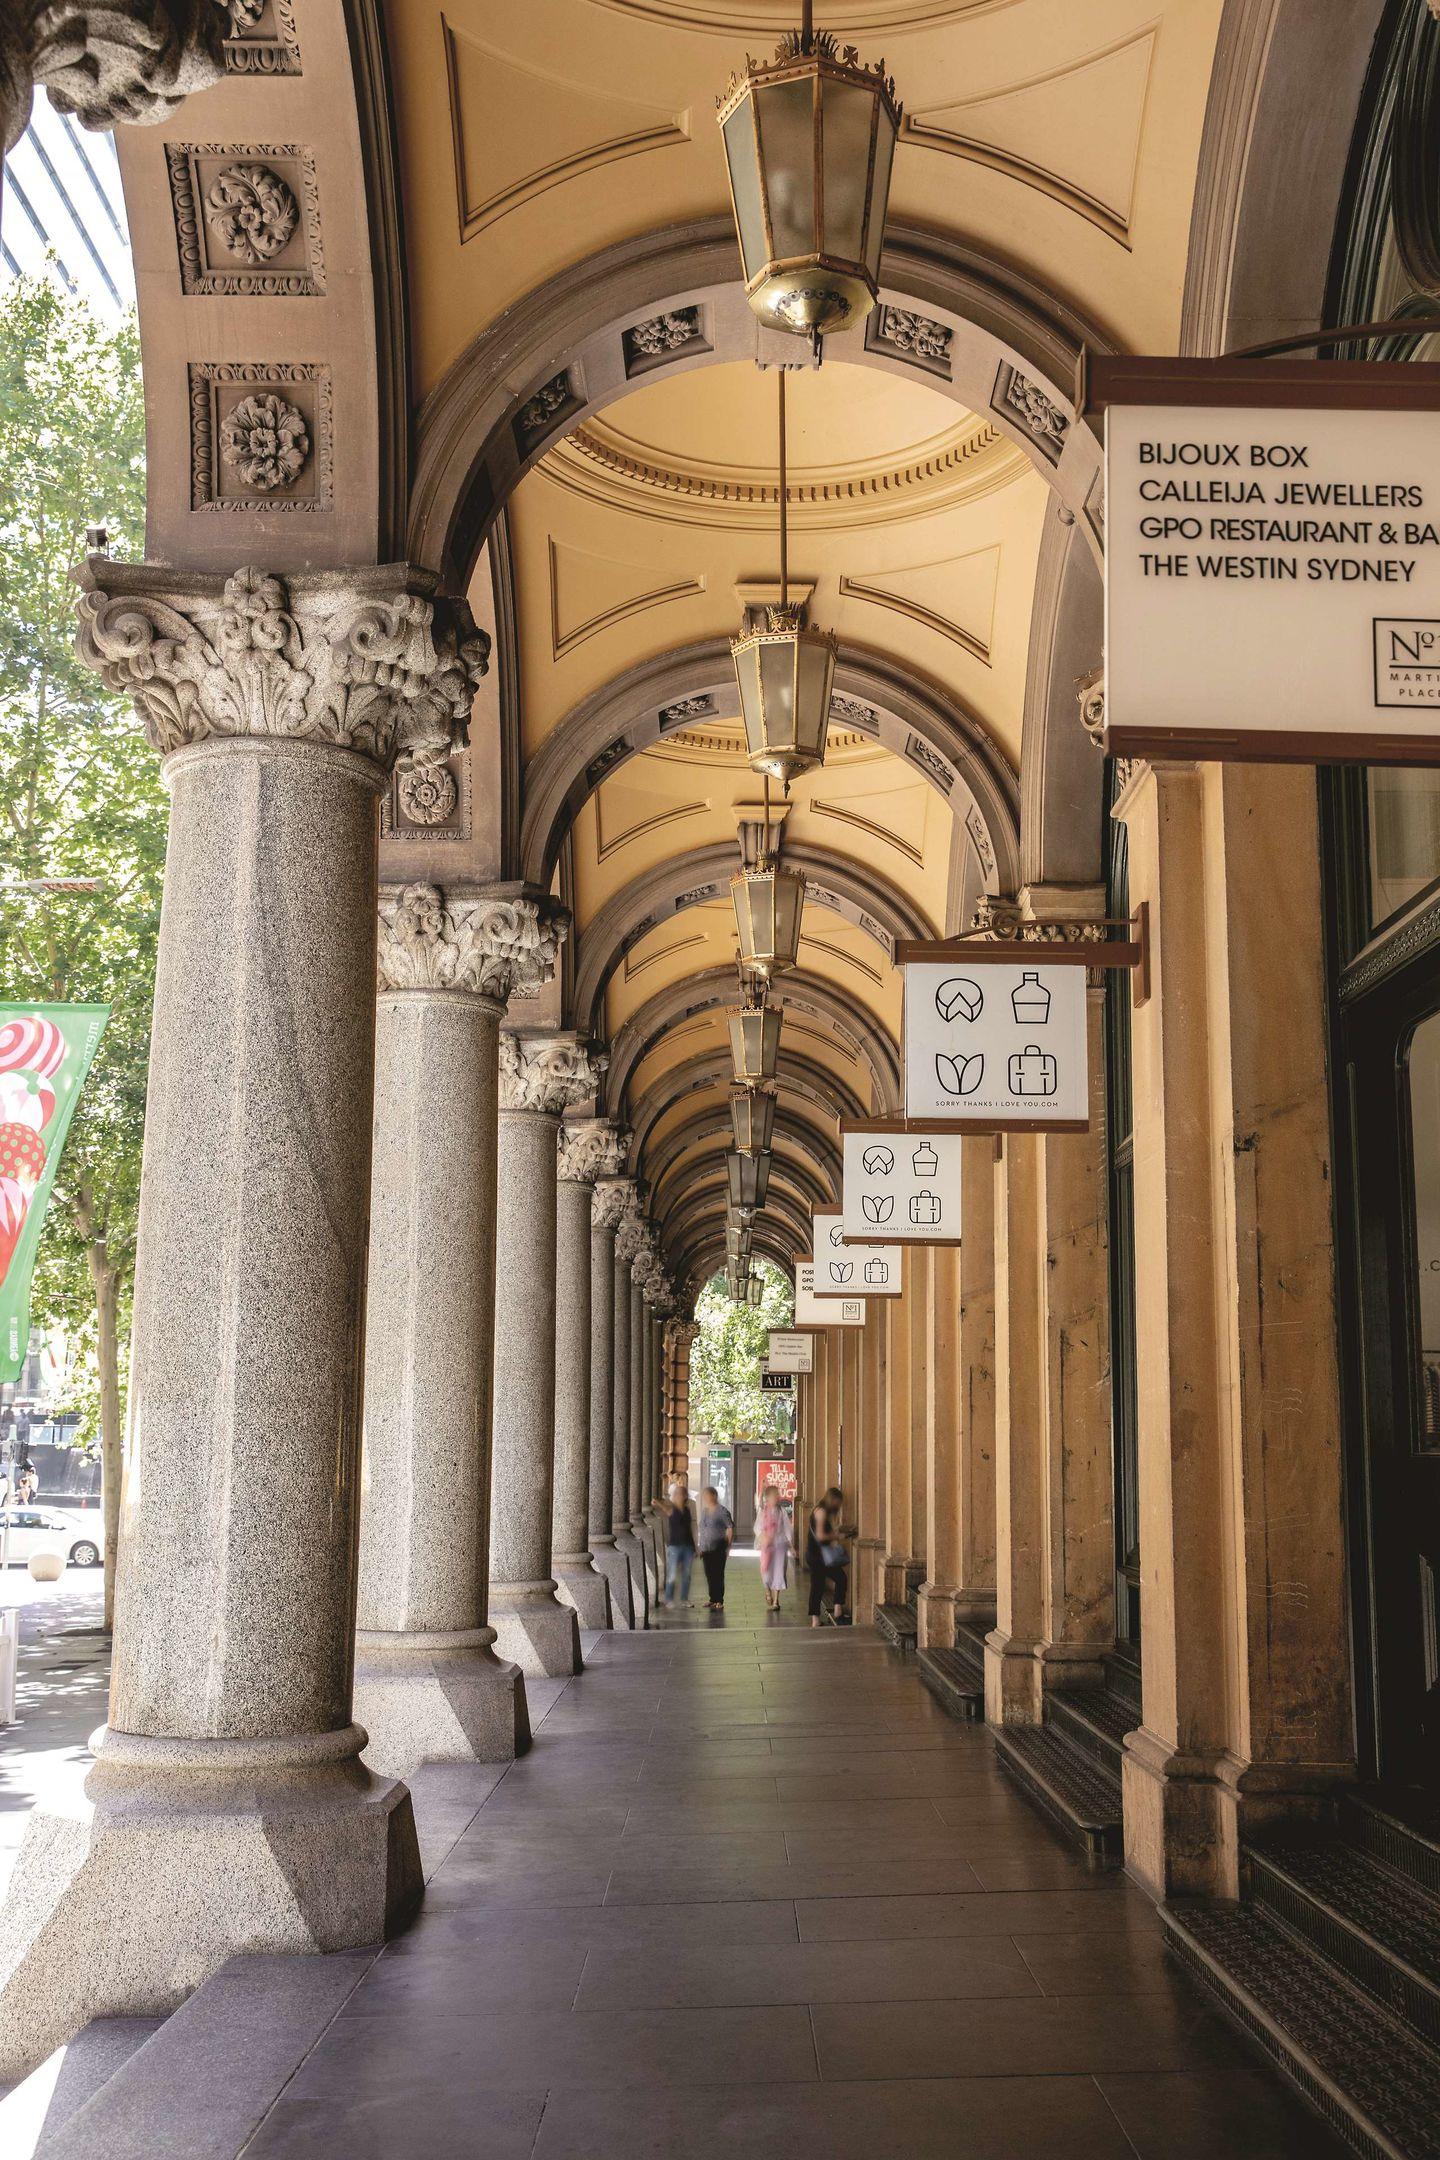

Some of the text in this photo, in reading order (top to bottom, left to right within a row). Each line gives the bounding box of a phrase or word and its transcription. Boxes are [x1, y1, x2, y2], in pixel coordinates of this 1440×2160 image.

[1139, 442, 1309, 468] BIJOUX BOX
[1138, 479, 1424, 508] CALLEIJA JEWELLERS
[1139, 517, 1204, 540] GPO
[1210, 518, 1373, 544] RESTAURANT
[1377, 522, 1398, 544] &
[1138, 554, 1416, 582] THE WESTIN SYDNEY
[765, 1376, 789, 1387] ART
[766, 1472, 796, 1483] SUGAR
